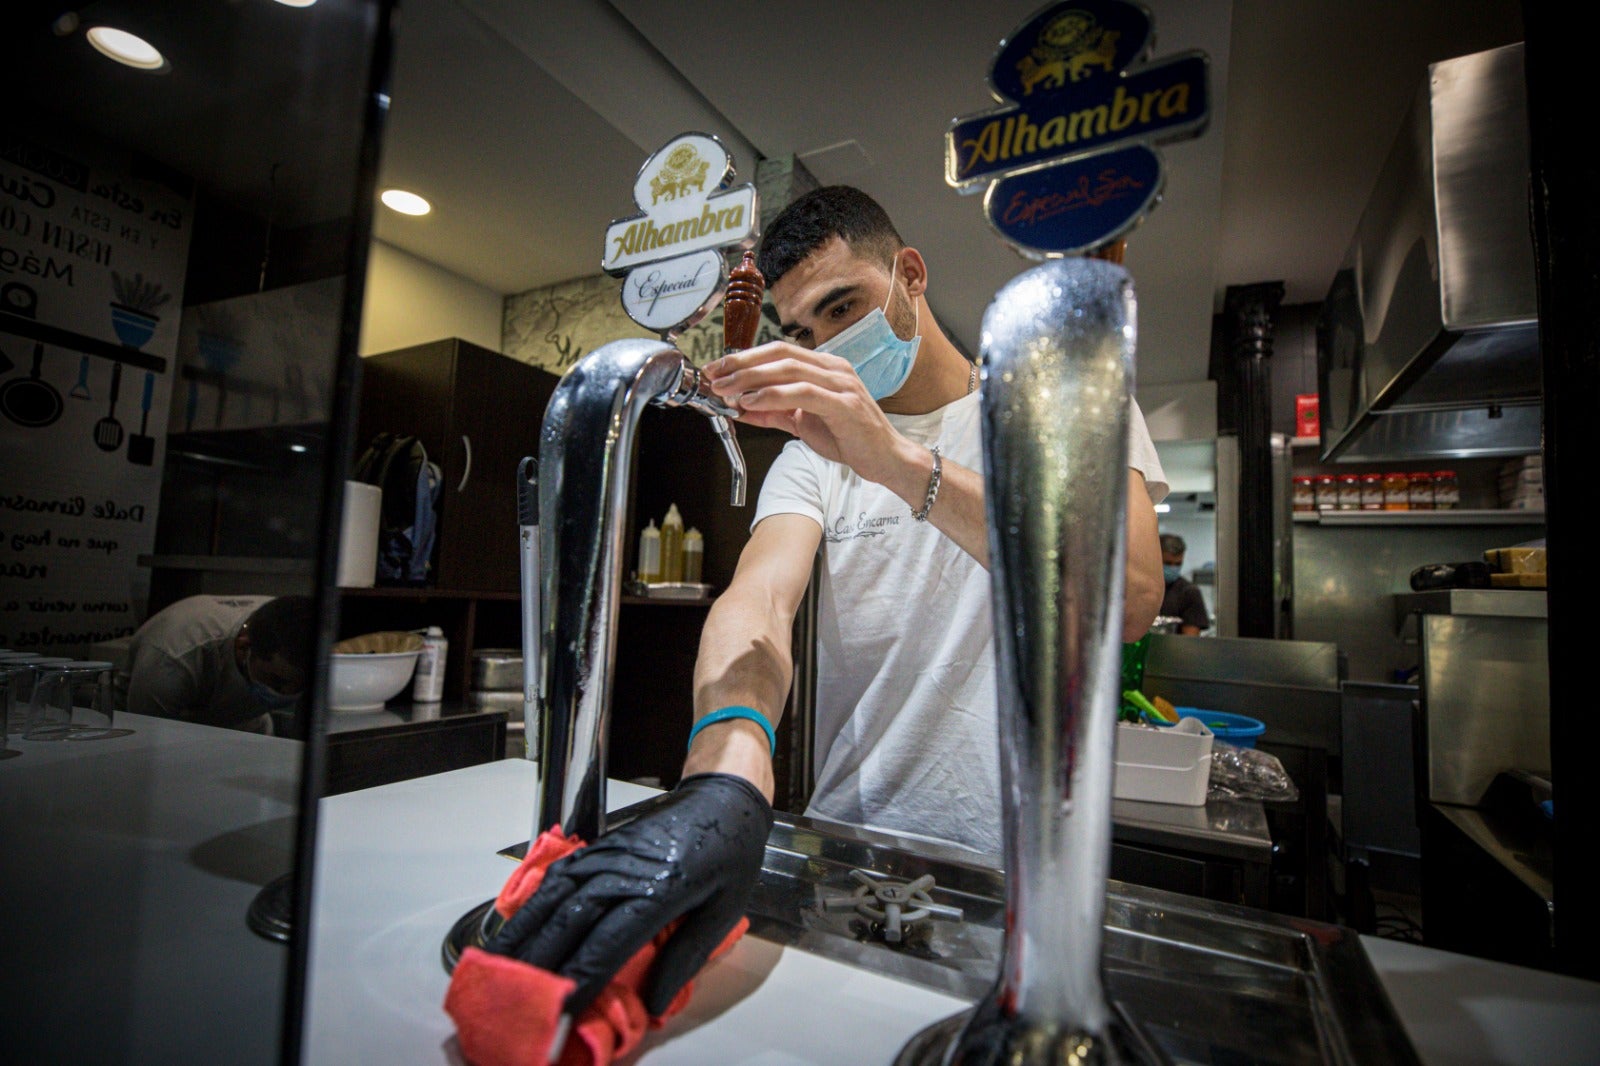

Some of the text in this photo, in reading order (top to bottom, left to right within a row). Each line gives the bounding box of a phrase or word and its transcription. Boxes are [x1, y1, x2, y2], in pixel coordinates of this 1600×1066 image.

[962, 82, 1190, 172] Alhambra
[611, 204, 744, 264] Alhambra
[634, 260, 710, 316] Especial
[857, 512, 899, 530] Encarna
